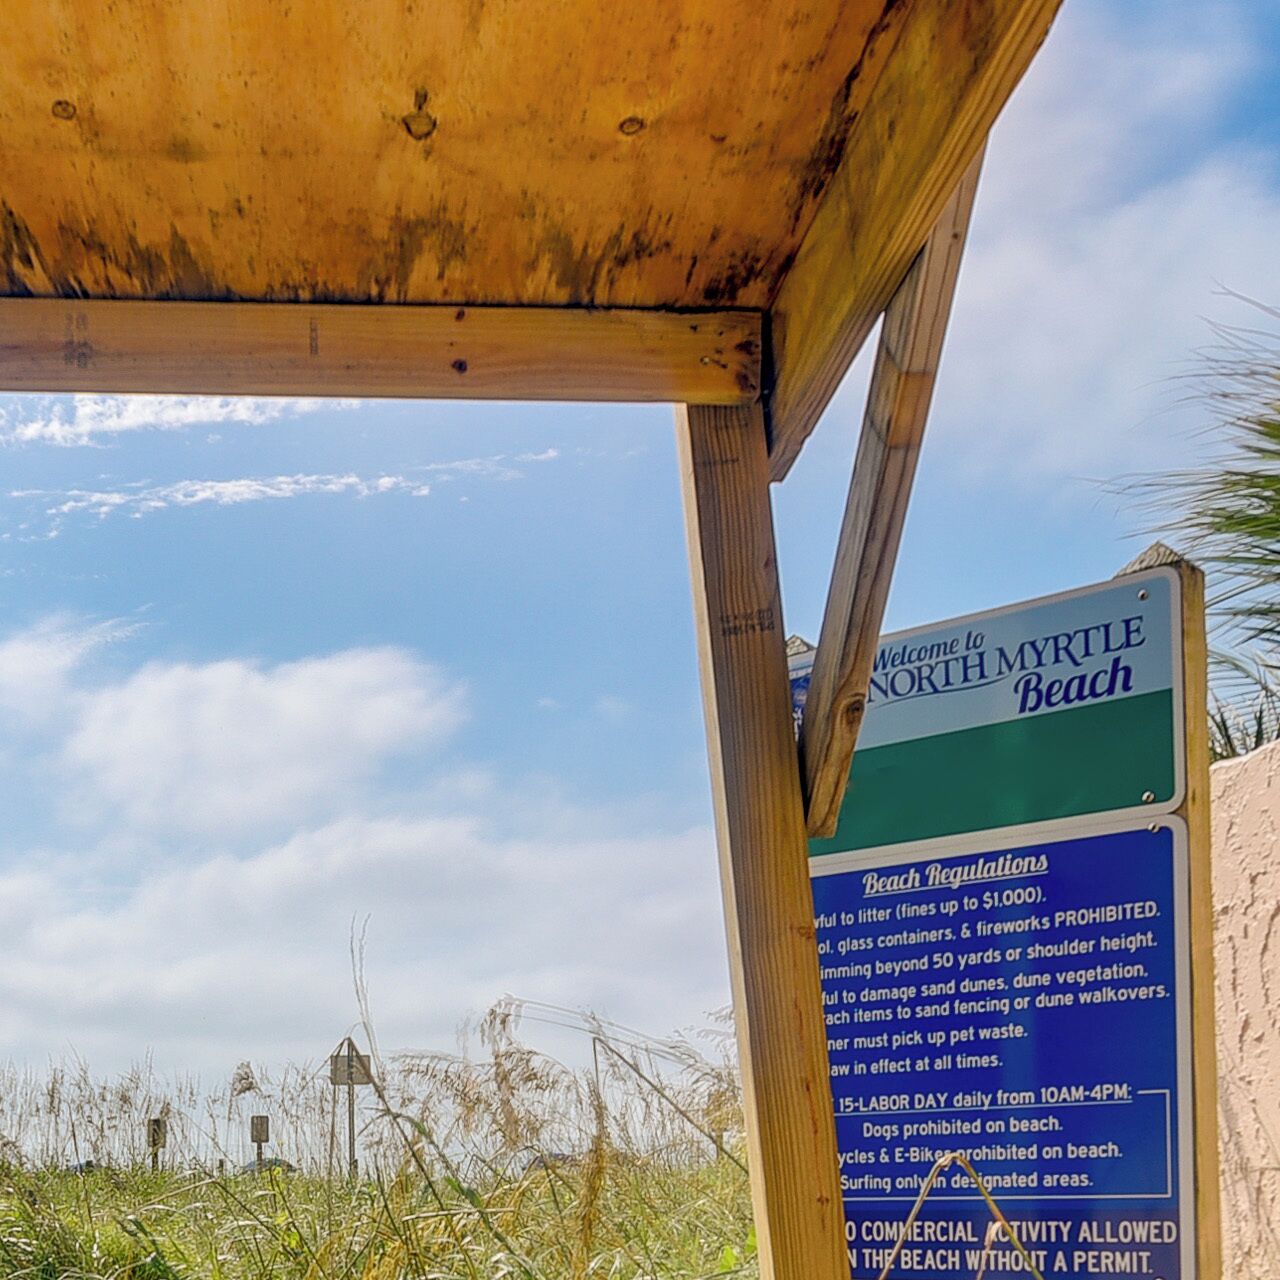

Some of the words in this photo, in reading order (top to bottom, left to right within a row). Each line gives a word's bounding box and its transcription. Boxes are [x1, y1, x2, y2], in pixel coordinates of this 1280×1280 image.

[867, 651, 989, 704] NORTH
[996, 615, 1146, 676] MYRTLE
[873, 638, 959, 672] Welcome
[965, 630, 986, 652] to
[1014, 657, 1133, 714] Beach
[862, 867, 920, 895] Beach
[925, 853, 1049, 889] Regulations
[841, 911, 855, 926] to
[858, 907, 891, 923] litter
[896, 901, 936, 920] (fines
[940, 899, 958, 916] up
[963, 896, 978, 910] to
[837, 937, 874, 956] glass
[960, 922, 972, 939] &
[976, 915, 1050, 937] fireworks
[1054, 900, 1161, 928] PROHIBITED.
[820, 961, 872, 980] imming
[875, 955, 929, 977] beyond
[932, 951, 954, 969] 50
[957, 948, 1002, 971] yards
[1005, 947, 1022, 961] or
[1026, 937, 1096, 960] shoulder
[1100, 930, 1158, 953] height.
[843, 989, 856, 1004] to
[860, 987, 916, 1003] damage
[920, 980, 956, 997] sand
[1013, 972, 1051, 989] dune
[853, 1007, 893, 1023] items
[896, 1004, 911, 1020] to
[915, 1001, 950, 1017] sand
[954, 997, 1010, 1015] fencing
[1014, 997, 1030, 1010] or
[1035, 992, 1074, 1008] dune
[1078, 984, 1171, 1005] walkovers.
[827, 1038, 850, 1052] ner
[853, 1032, 889, 1049] must
[892, 1030, 924, 1051] pick
[927, 1030, 946, 1047] up
[950, 1026, 975, 1046] pet
[978, 1022, 1028, 1040] waste.
[830, 1064, 850, 1077] aw
[853, 1060, 867, 1075] in
[870, 1057, 911, 1074] effect
[915, 1056, 930, 1072] at
[934, 1055, 952, 1070] all
[955, 1053, 1003, 1070] times.
[839, 1093, 910, 1113] 15-LABOR
[914, 1092, 948, 1110] DAY
[953, 1089, 993, 1111] daily
[997, 1088, 1036, 1105] from
[1040, 1083, 1133, 1104] 10AM-4PM:
[863, 1122, 899, 1141] Dogs
[903, 1118, 982, 1140] prohibited
[985, 1119, 1005, 1133] on
[1009, 1115, 1064, 1133] beach.
[837, 1148, 876, 1169] ycles
[879, 1147, 890, 1163] &
[894, 1146, 951, 1163] E-Bikes
[956, 1143, 1038, 1165] prohibited
[1042, 1145, 1063, 1160] on
[1067, 1142, 1123, 1159] beach.
[840, 1174, 892, 1193] Surfing
[951, 1172, 1039, 1192] designated
[1043, 1171, 1094, 1188] areas.
[845, 1221, 856, 1241] O
[861, 1221, 979, 1242] COMMERCIAL
[984, 1221, 1072, 1243] ACTIVITY
[1078, 1221, 1177, 1244] ALLOWED
[847, 1248, 857, 1269] N
[862, 1248, 895, 1269] THE
[900, 1249, 960, 1271] BEACH
[965, 1250, 1048, 1271] WITHOUT
[1053, 1251, 1068, 1272] A
[1073, 1251, 1153, 1273] PERMIT.
